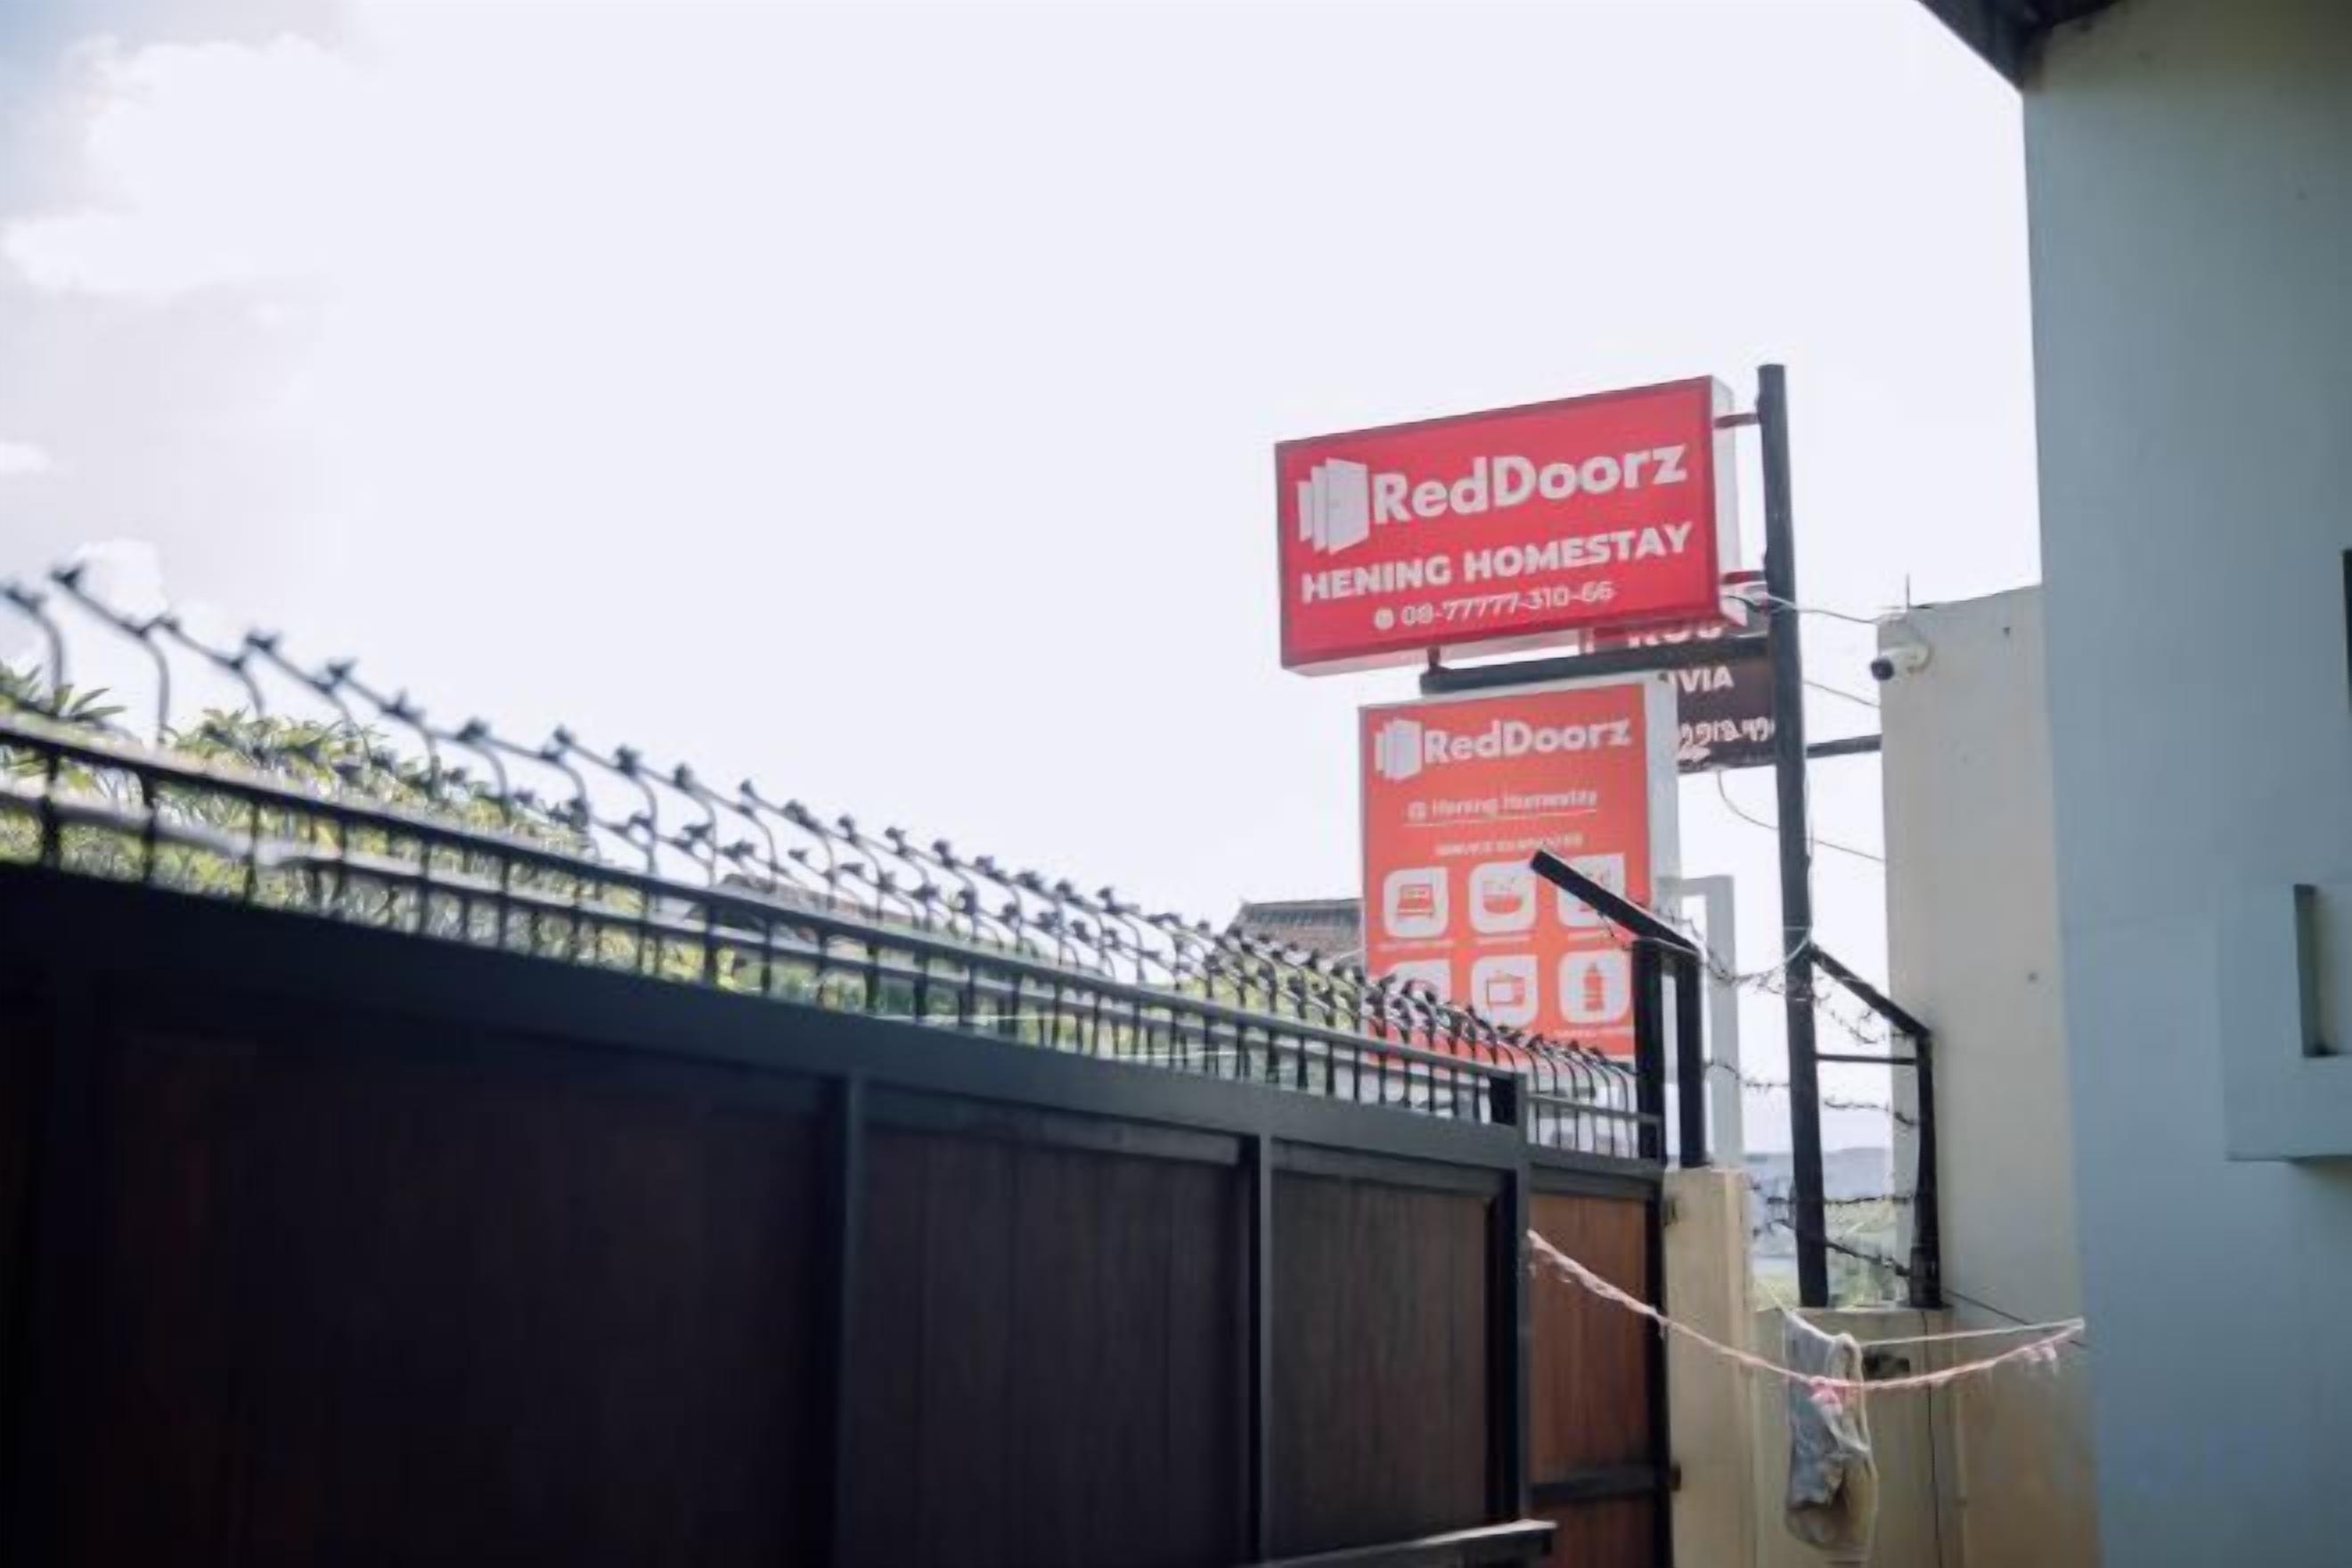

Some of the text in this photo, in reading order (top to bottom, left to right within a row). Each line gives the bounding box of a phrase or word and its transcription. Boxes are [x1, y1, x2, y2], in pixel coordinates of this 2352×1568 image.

[1371, 443, 1688, 525] RedDoorz
[1301, 521, 1693, 603] HENING HOMESTAY
[1425, 717, 1631, 764] RedDoorz
